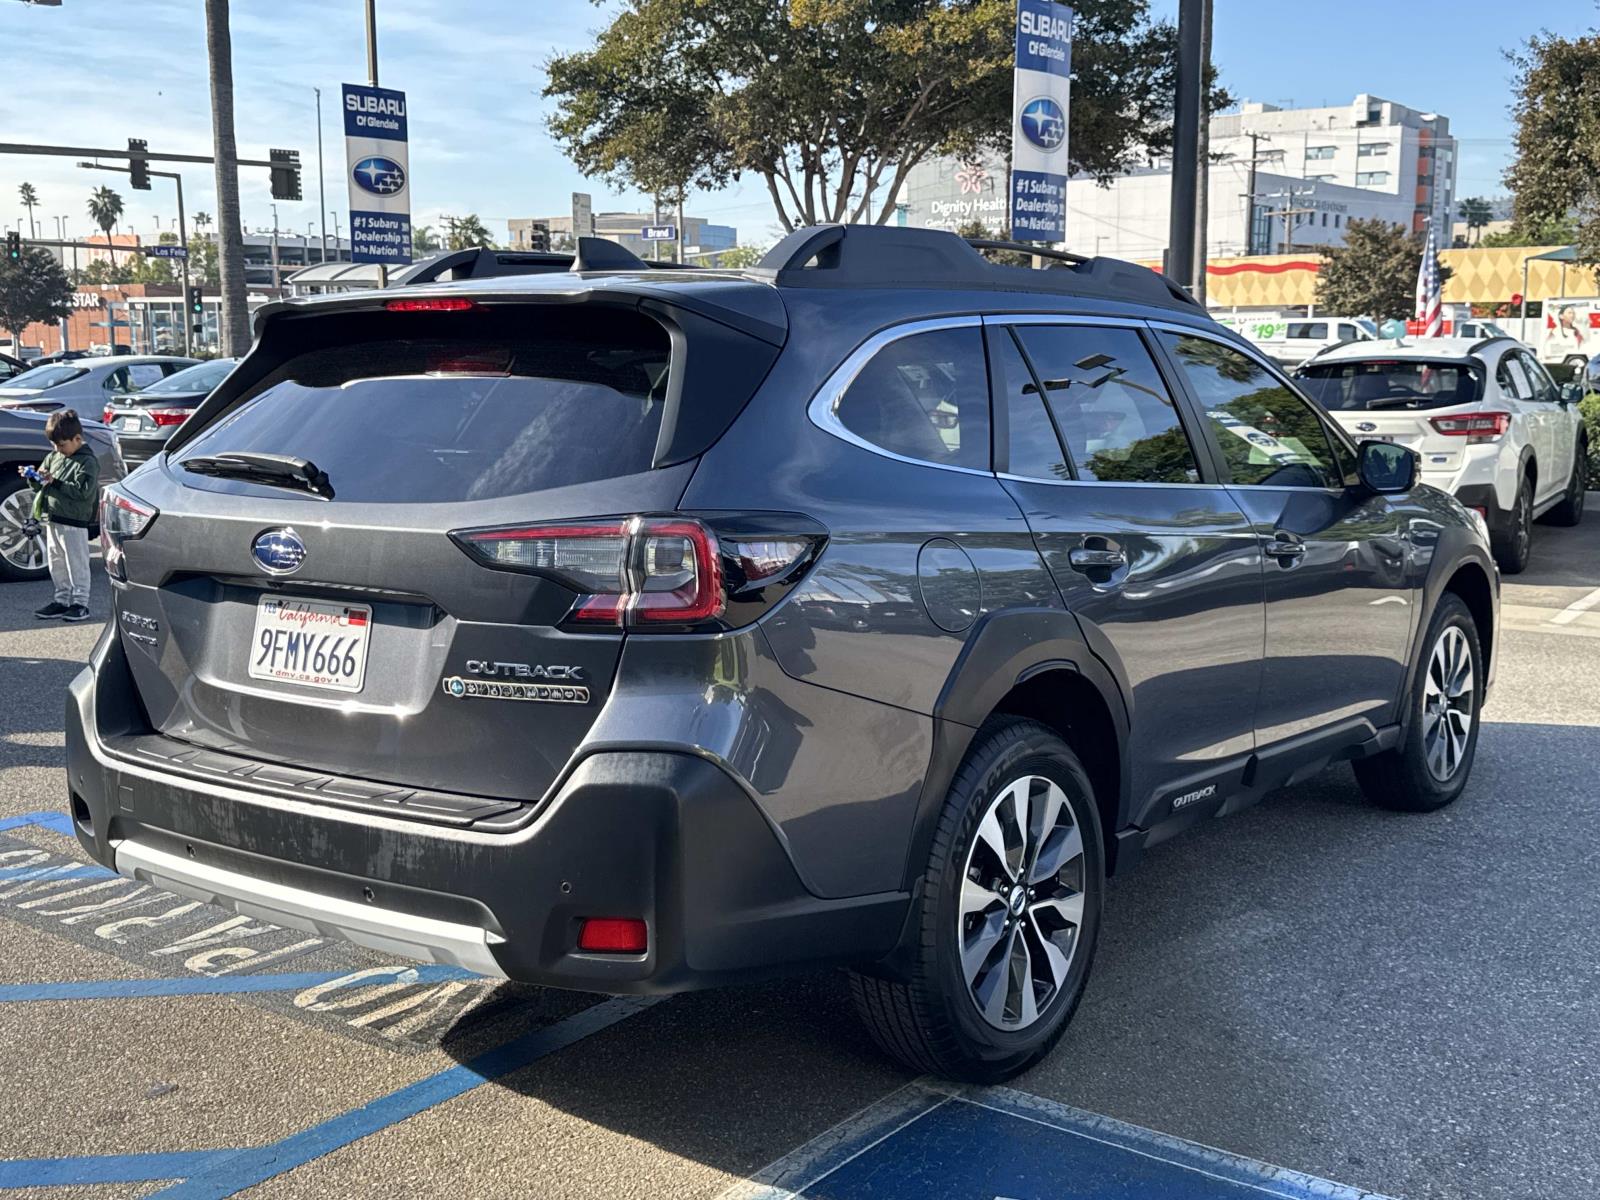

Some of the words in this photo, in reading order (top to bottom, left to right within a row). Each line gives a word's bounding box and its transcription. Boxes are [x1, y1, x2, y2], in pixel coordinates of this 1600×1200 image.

[1020, 10, 1071, 44] SUBARU
[1028, 40, 1039, 56] Of
[345, 93, 405, 117] SUBARU
[356, 115, 367, 127] Of
[367, 116, 399, 131] Glendale
[1016, 178, 1030, 194] #1
[1030, 180, 1058, 196] Subaru
[931, 199, 972, 217] Dignity
[1016, 197, 1059, 217] Dealership
[353, 216, 367, 229] #1
[367, 217, 399, 230] Subaru
[1029, 216, 1056, 232] Nation
[354, 230, 402, 246] Dealership
[647, 228, 669, 238] Brand
[154, 247, 168, 257] Los
[169, 247, 187, 258] Feliz
[369, 244, 399, 257] Nation
[279, 601, 349, 629] California
[256, 627, 361, 678] 9FMY666
[275, 669, 333, 684] dmv.ca.gov
[465, 659, 584, 680] OUTBACK
[1172, 784, 1216, 808] OUTBACK
